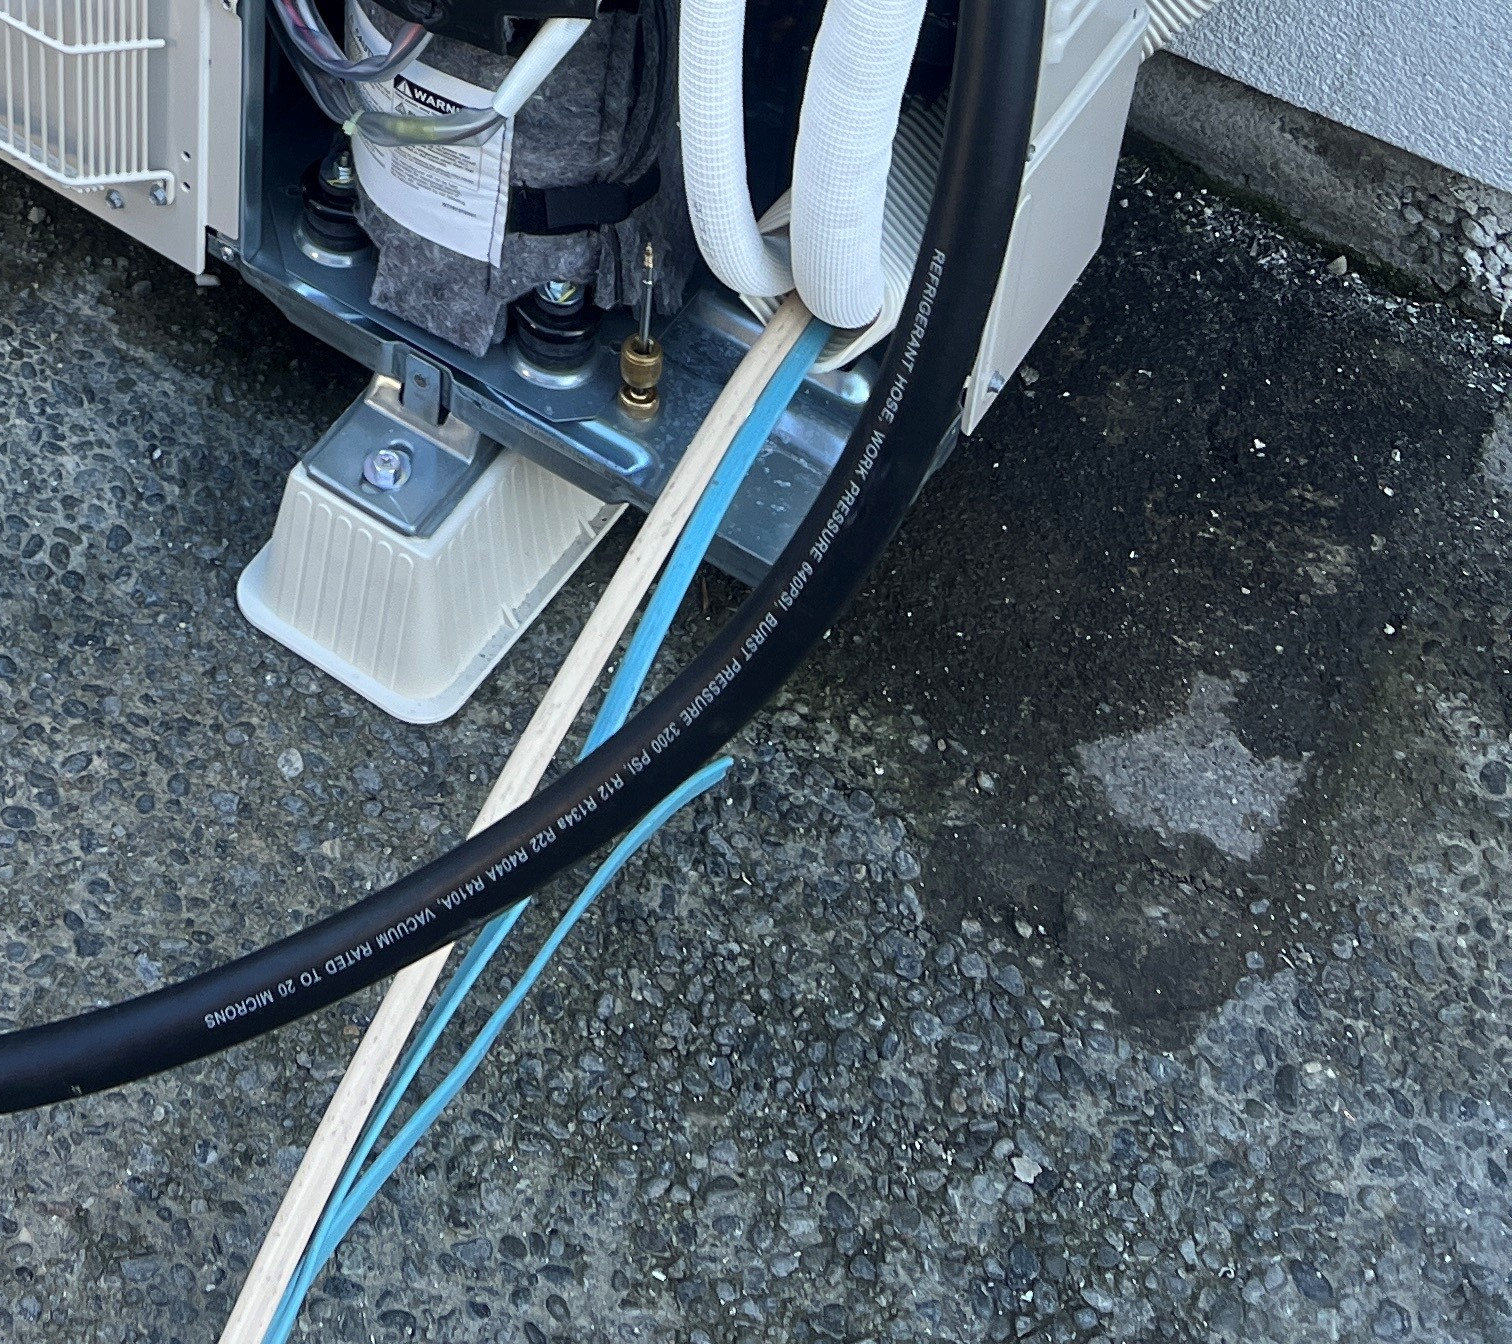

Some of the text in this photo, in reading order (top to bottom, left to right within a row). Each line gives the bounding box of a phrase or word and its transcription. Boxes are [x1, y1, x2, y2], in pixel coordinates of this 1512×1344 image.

[204, 248, 946, 1030] REFRIGERANT HOSE, WORK PRESSURE 640PSI, BURST PRESSURE 3200 PSI, R12 R134a R22 R404A R410A, VACUUM RATED TO 20 MICRONS
